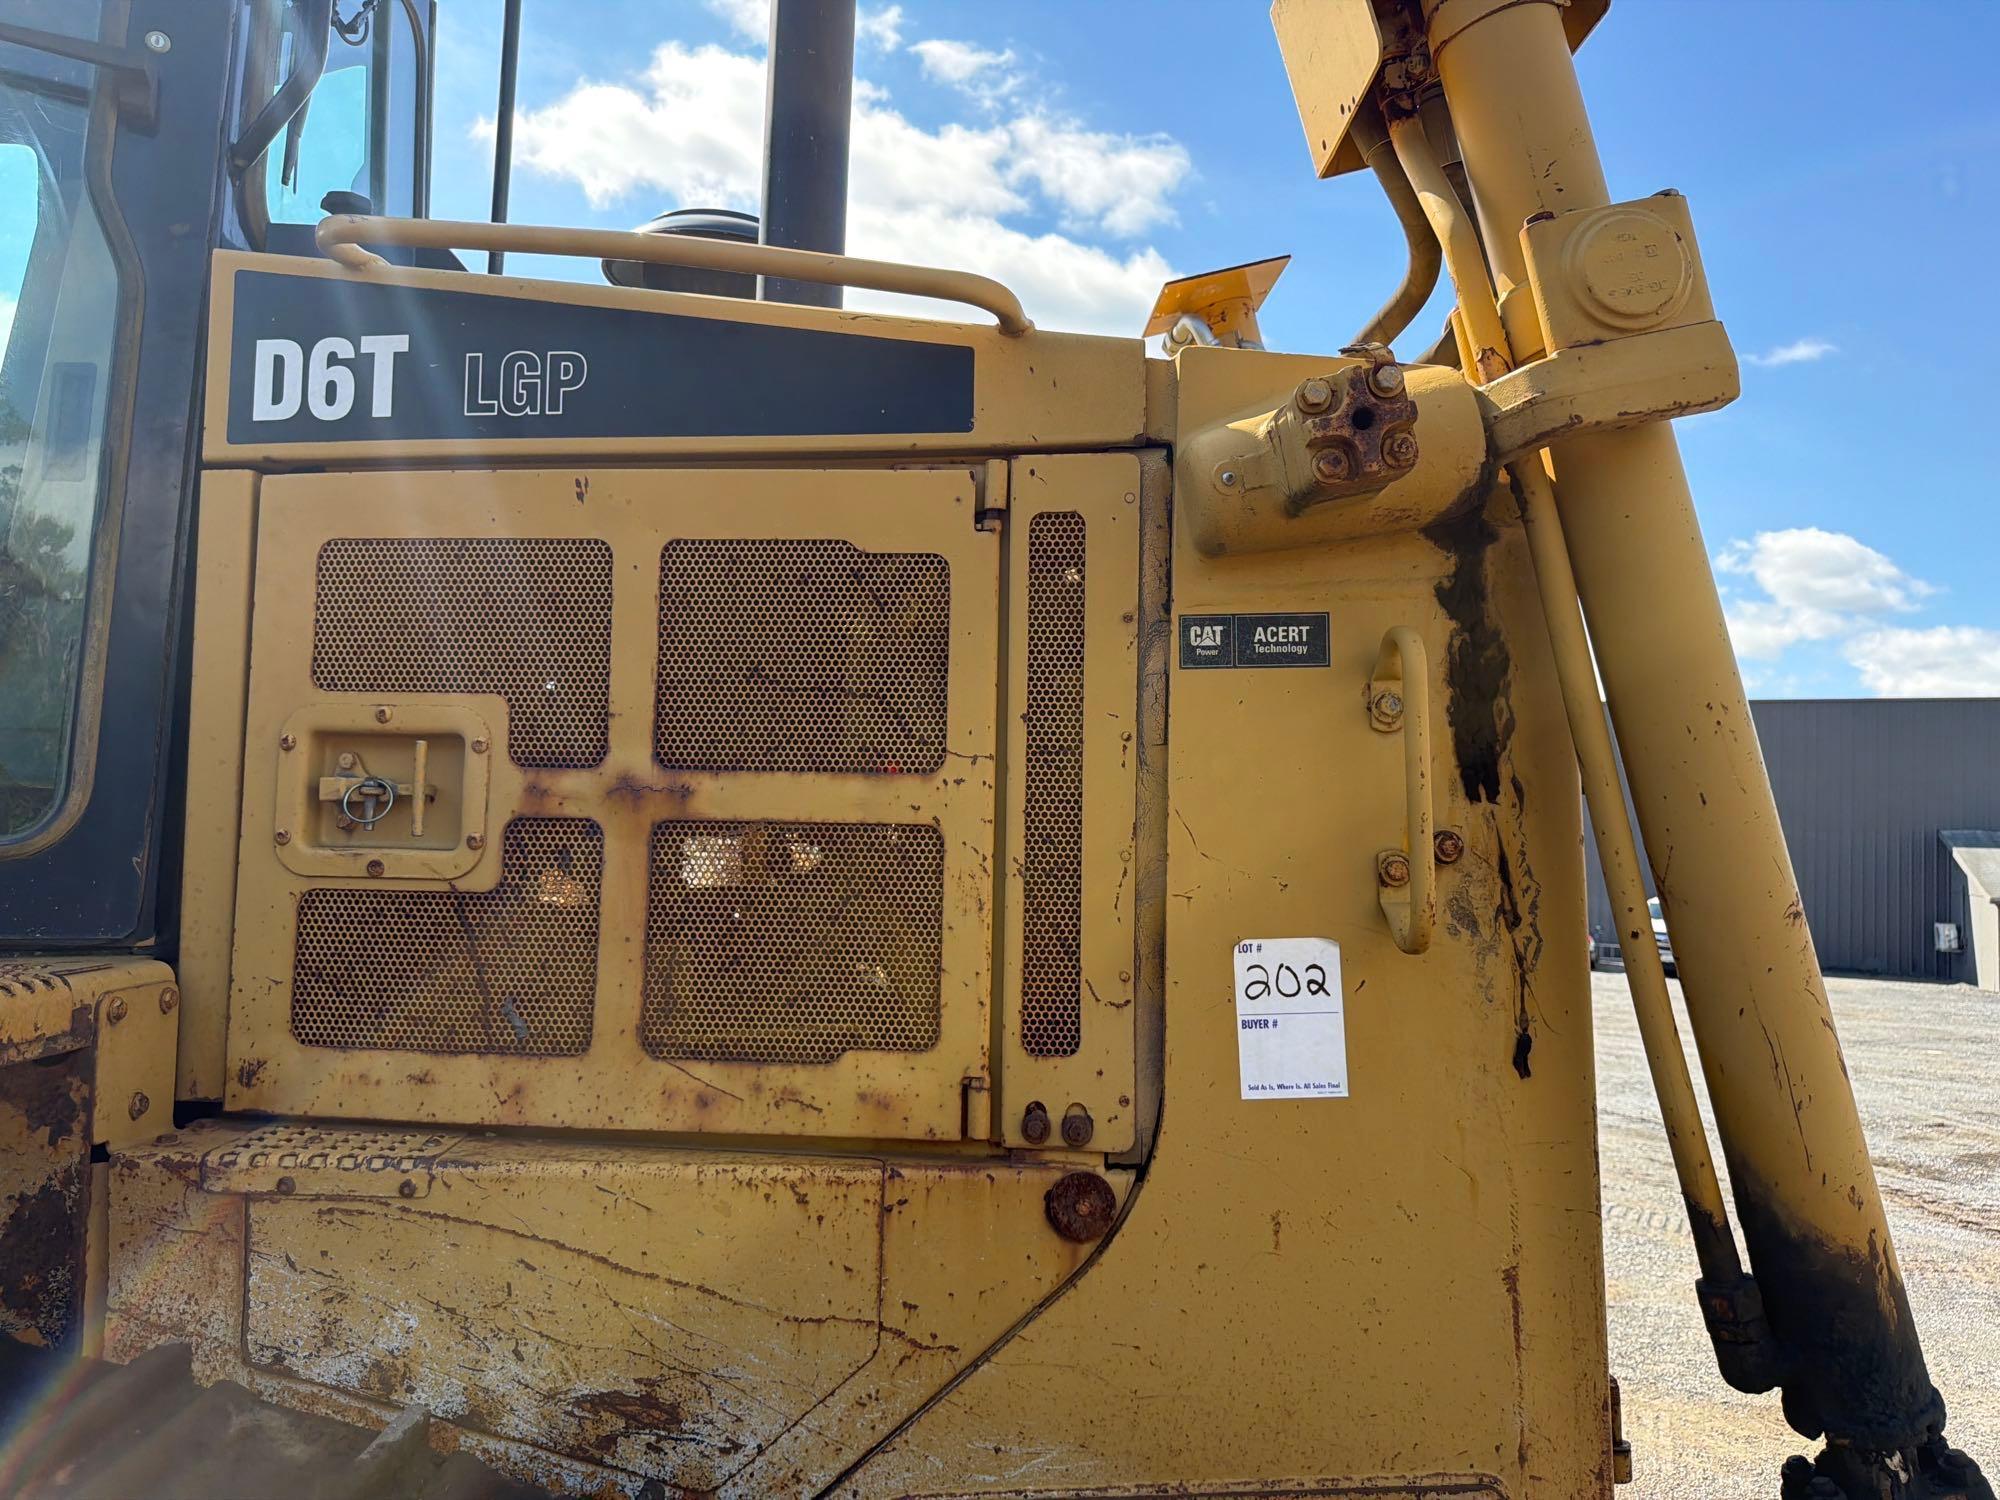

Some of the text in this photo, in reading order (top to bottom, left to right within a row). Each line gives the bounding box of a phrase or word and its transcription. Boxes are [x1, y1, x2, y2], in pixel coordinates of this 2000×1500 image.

[253, 334, 588, 421] D6T LGP
[1190, 625, 1223, 646] CAT
[1254, 626, 1309, 643] ACERT
[1196, 648, 1218, 656] Power
[1254, 643, 1308, 655] Technology
[1238, 943, 1262, 953] LOT #
[1244, 963, 1331, 1000] 202
[1241, 1019, 1278, 1029] BUYER #
